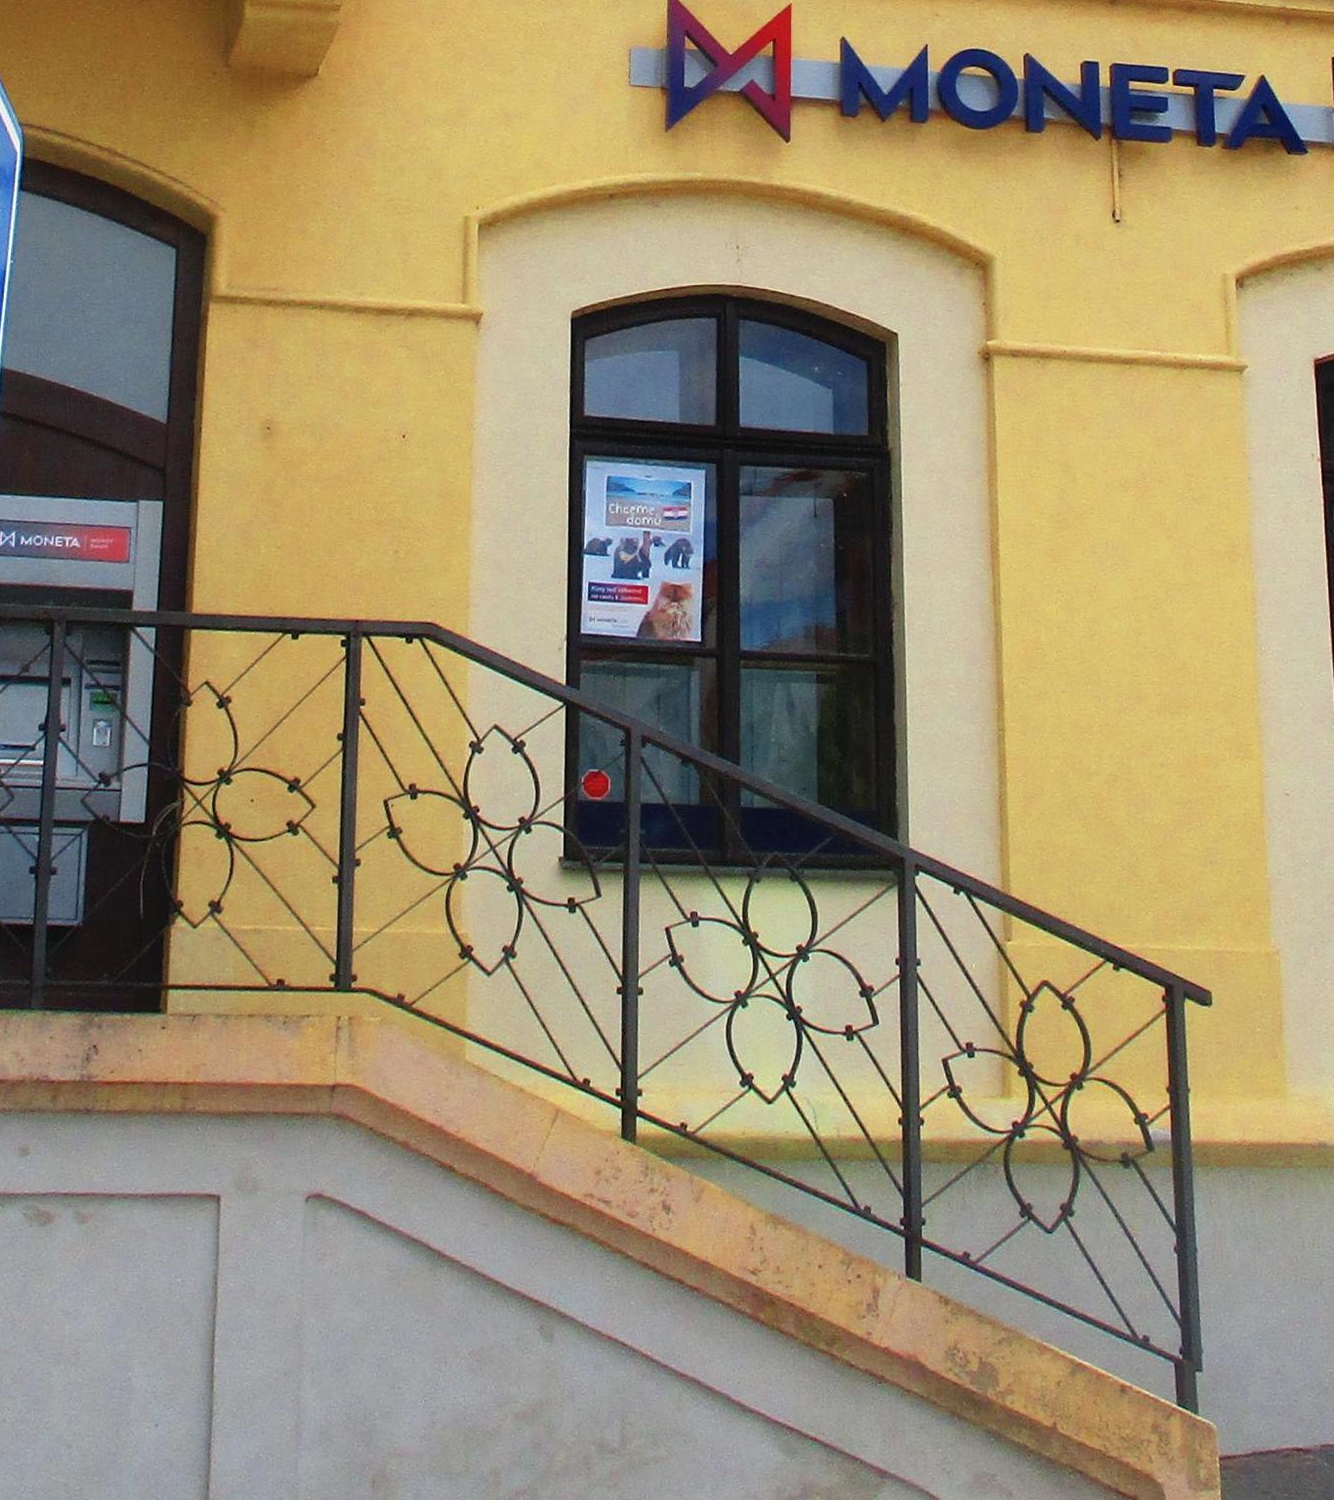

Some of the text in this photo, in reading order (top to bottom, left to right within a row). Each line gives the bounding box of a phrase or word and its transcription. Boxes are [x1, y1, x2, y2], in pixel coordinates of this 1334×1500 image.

[840, 35, 1309, 156] MONETA
[608, 503, 655, 515] Chceme
[20, 535, 80, 548] MONETA
